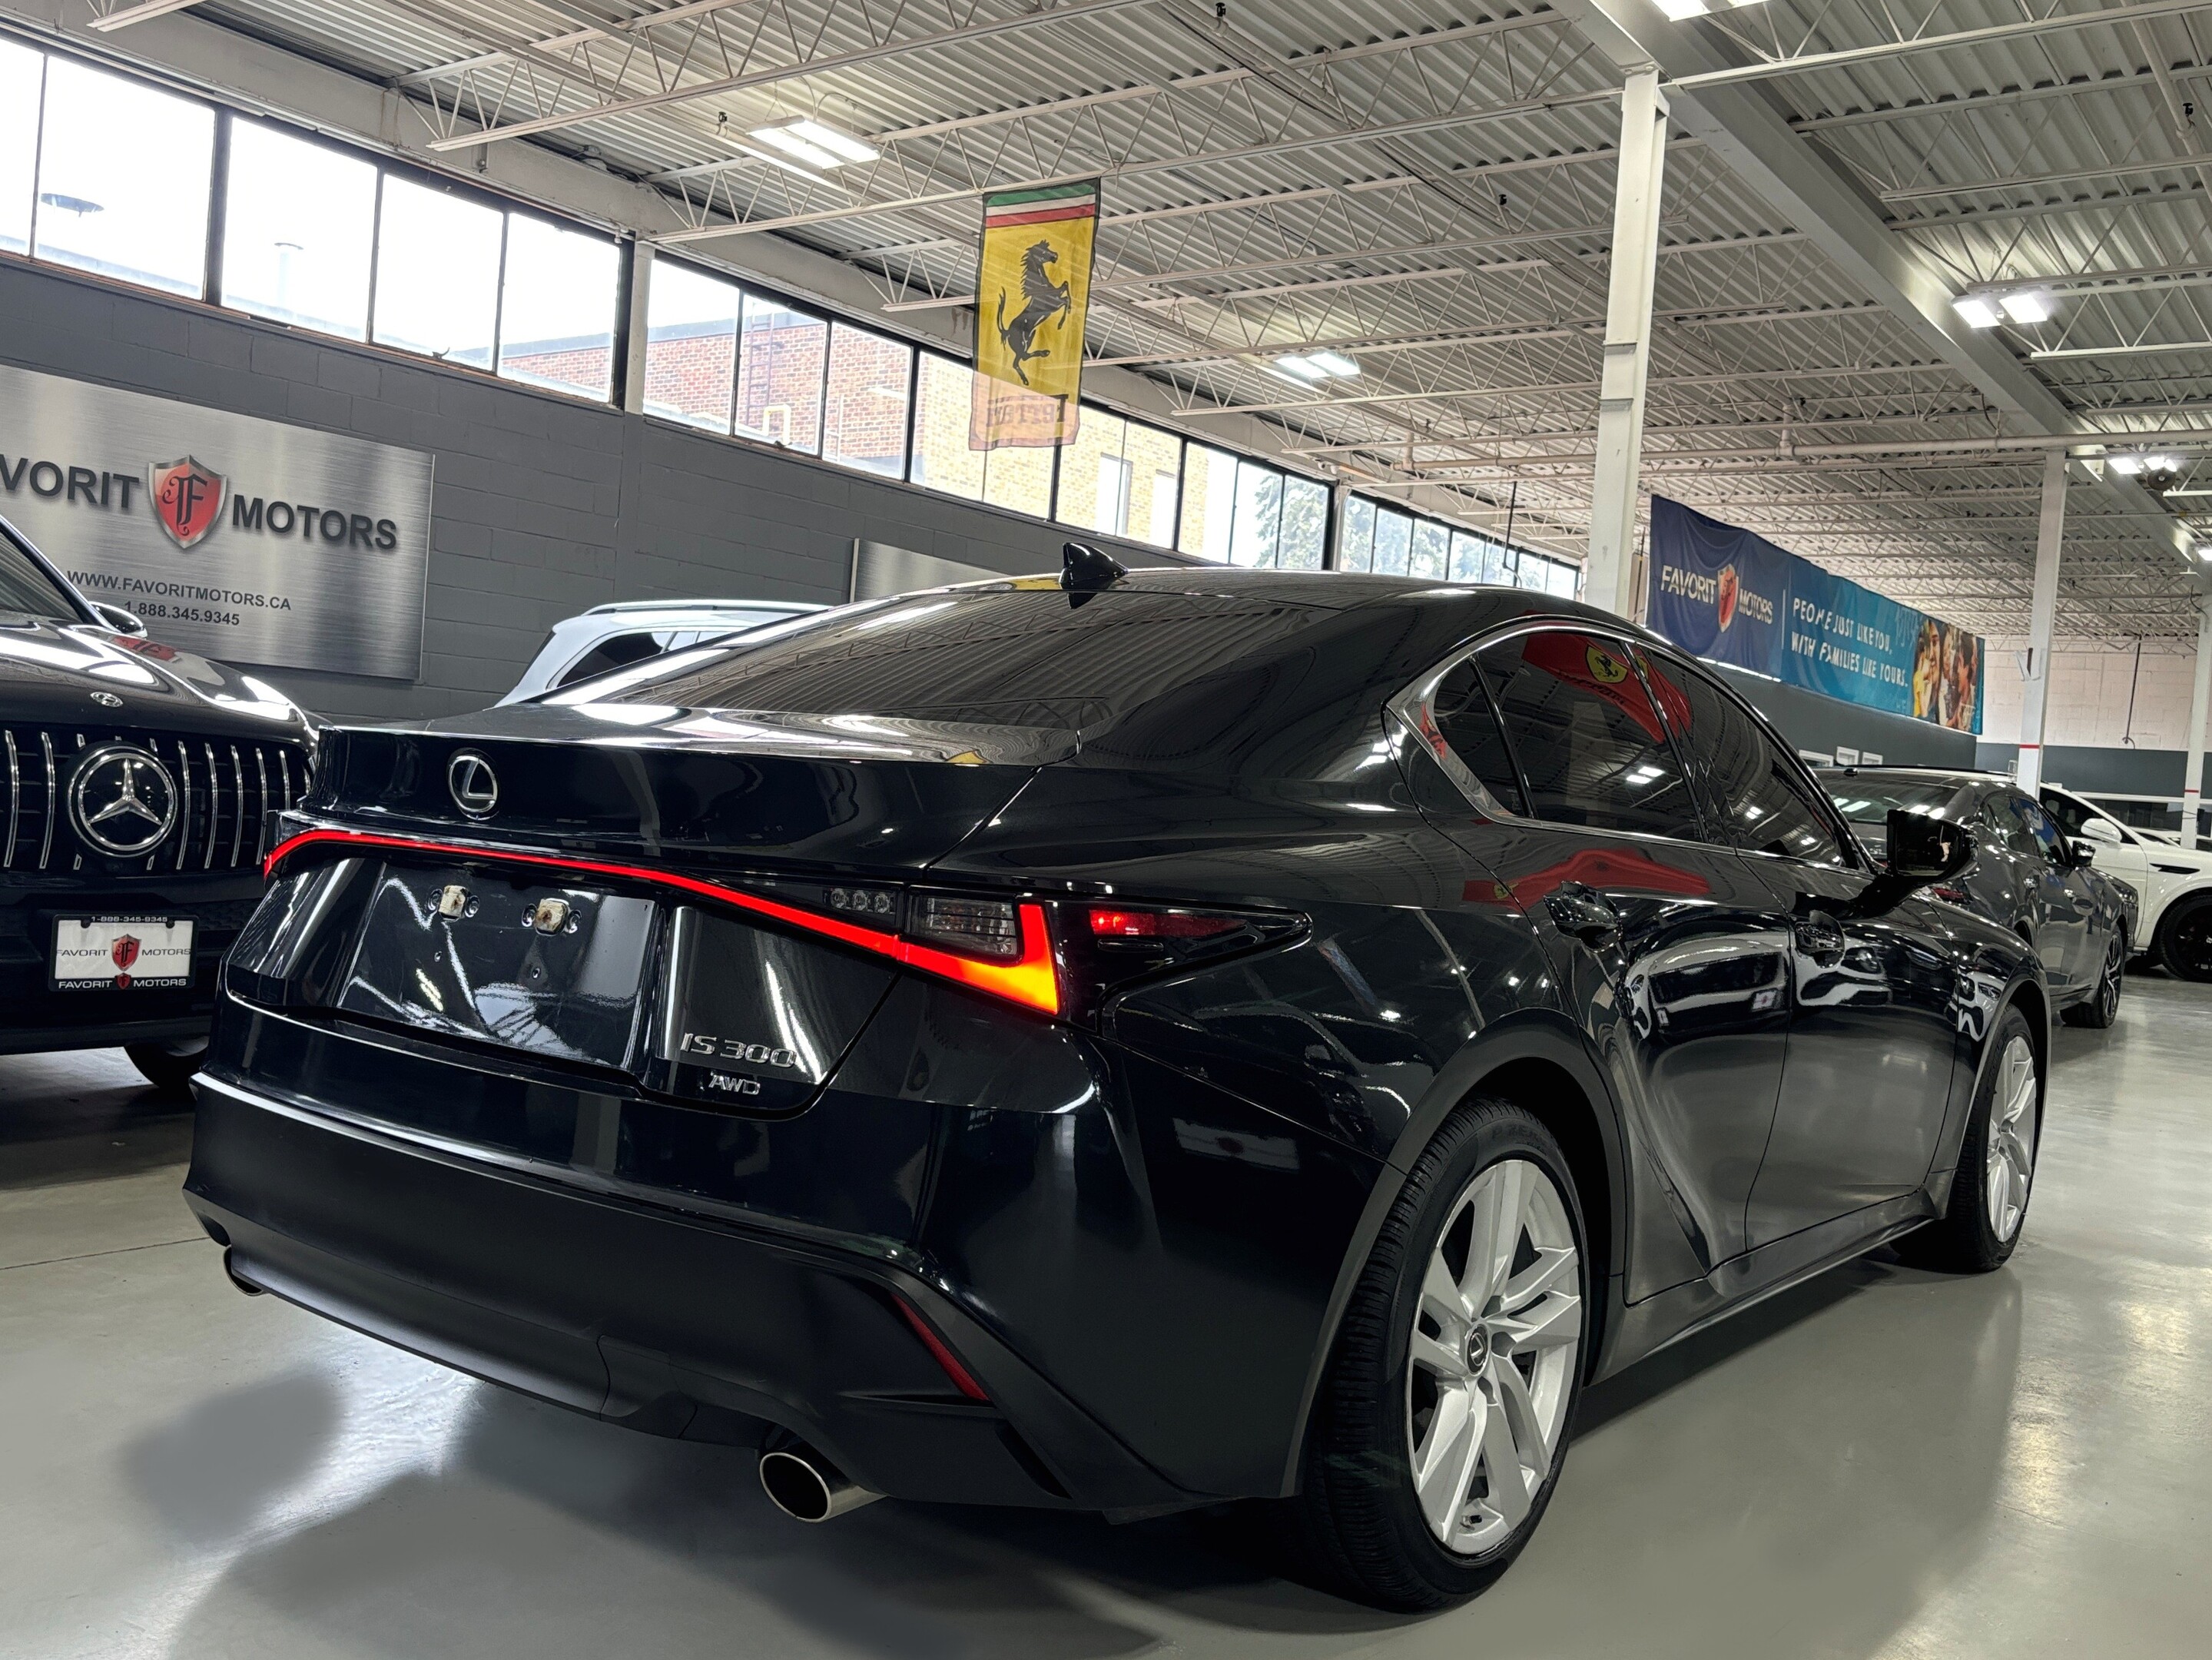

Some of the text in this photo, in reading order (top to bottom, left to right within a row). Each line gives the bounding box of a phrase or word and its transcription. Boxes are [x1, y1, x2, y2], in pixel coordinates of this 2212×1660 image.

[232, 493, 397, 550] MOTORS
[67, 570, 292, 611] WWW.FAVORITMOTORS.CA
[1660, 565, 1716, 605] FAVORIT
[1739, 589, 1773, 625] MOTORS
[124, 600, 240, 626] 1.888.345.9345
[1832, 614, 1854, 639] JUST
[1856, 622, 1875, 646] LIKE
[1791, 631, 1909, 688] WITH FAMILIES LIKE YOURS.
[58, 980, 113, 989] FAVORIT
[133, 978, 187, 988] MOTORS
[680, 1032, 798, 1069] IS 300
[708, 1074, 761, 1096] AWD
